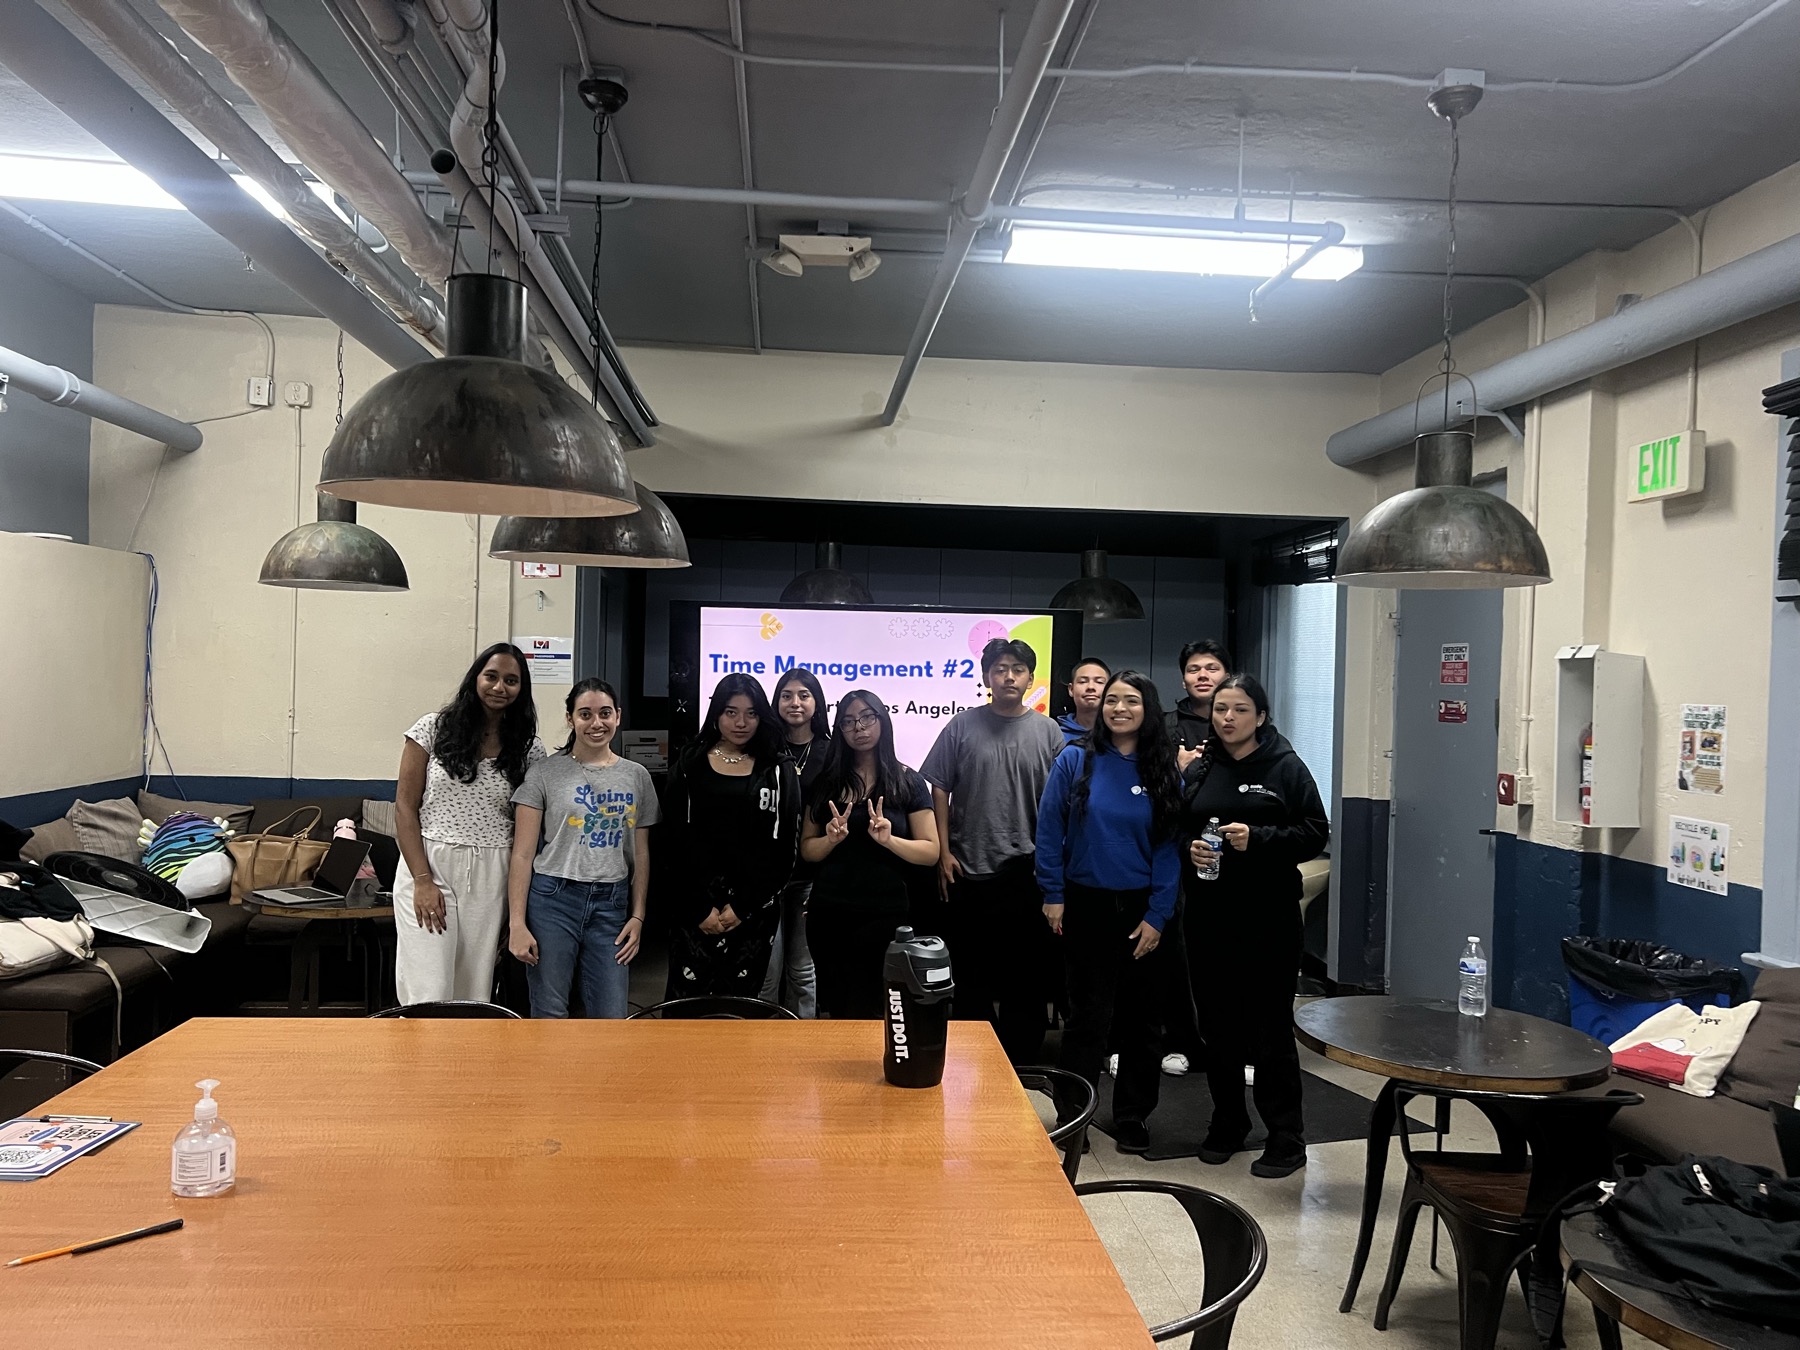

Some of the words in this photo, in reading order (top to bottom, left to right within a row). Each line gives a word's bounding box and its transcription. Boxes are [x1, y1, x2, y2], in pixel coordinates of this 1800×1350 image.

[1638, 436, 1680, 494] EXIT
[709, 653, 766, 674] Time
[775, 655, 933, 681] Management
[942, 659, 974, 678] #2
[574, 784, 634, 813] Living
[608, 805, 625, 814] my
[589, 830, 623, 848] Lif
[889, 988, 904, 1022] JUST
[892, 1023, 906, 1044] DO
[894, 1045, 909, 1063] IT.
